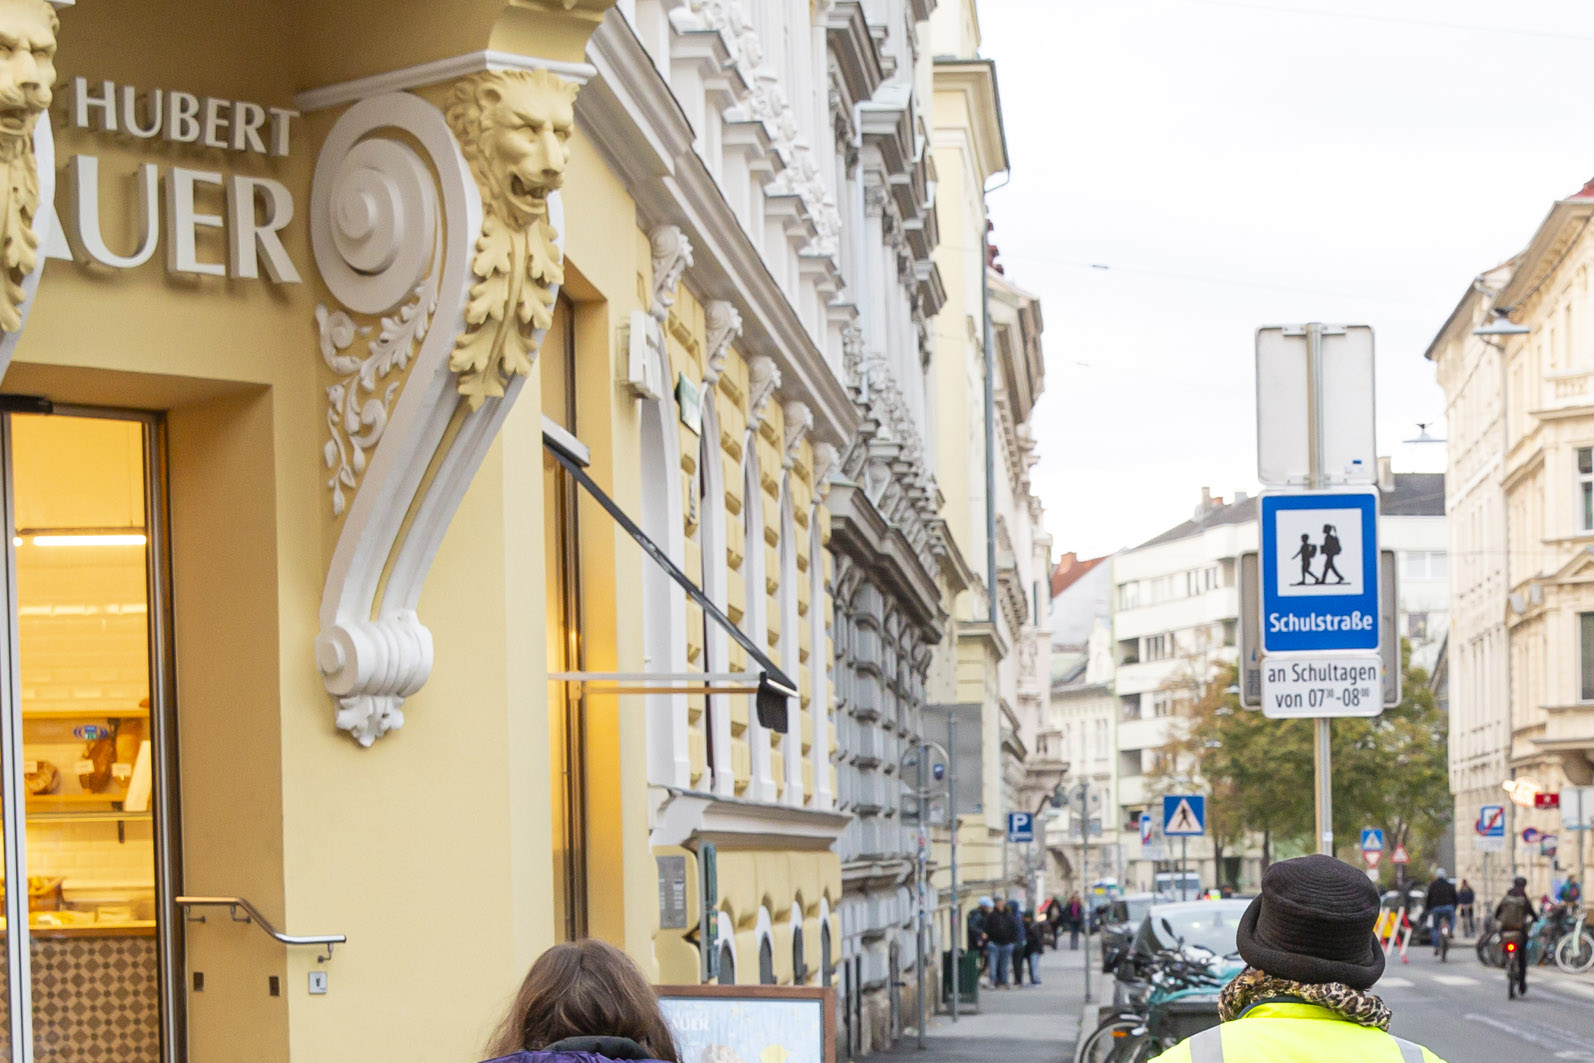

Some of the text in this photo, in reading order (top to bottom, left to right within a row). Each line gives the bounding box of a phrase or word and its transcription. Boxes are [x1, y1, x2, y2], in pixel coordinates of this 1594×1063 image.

[75, 76, 300, 157] HUBERT
[1269, 611, 1373, 632] Schulstraße
[1268, 668, 1286, 683] an
[1292, 663, 1377, 685] Schultagen
[1275, 693, 1303, 708] von
